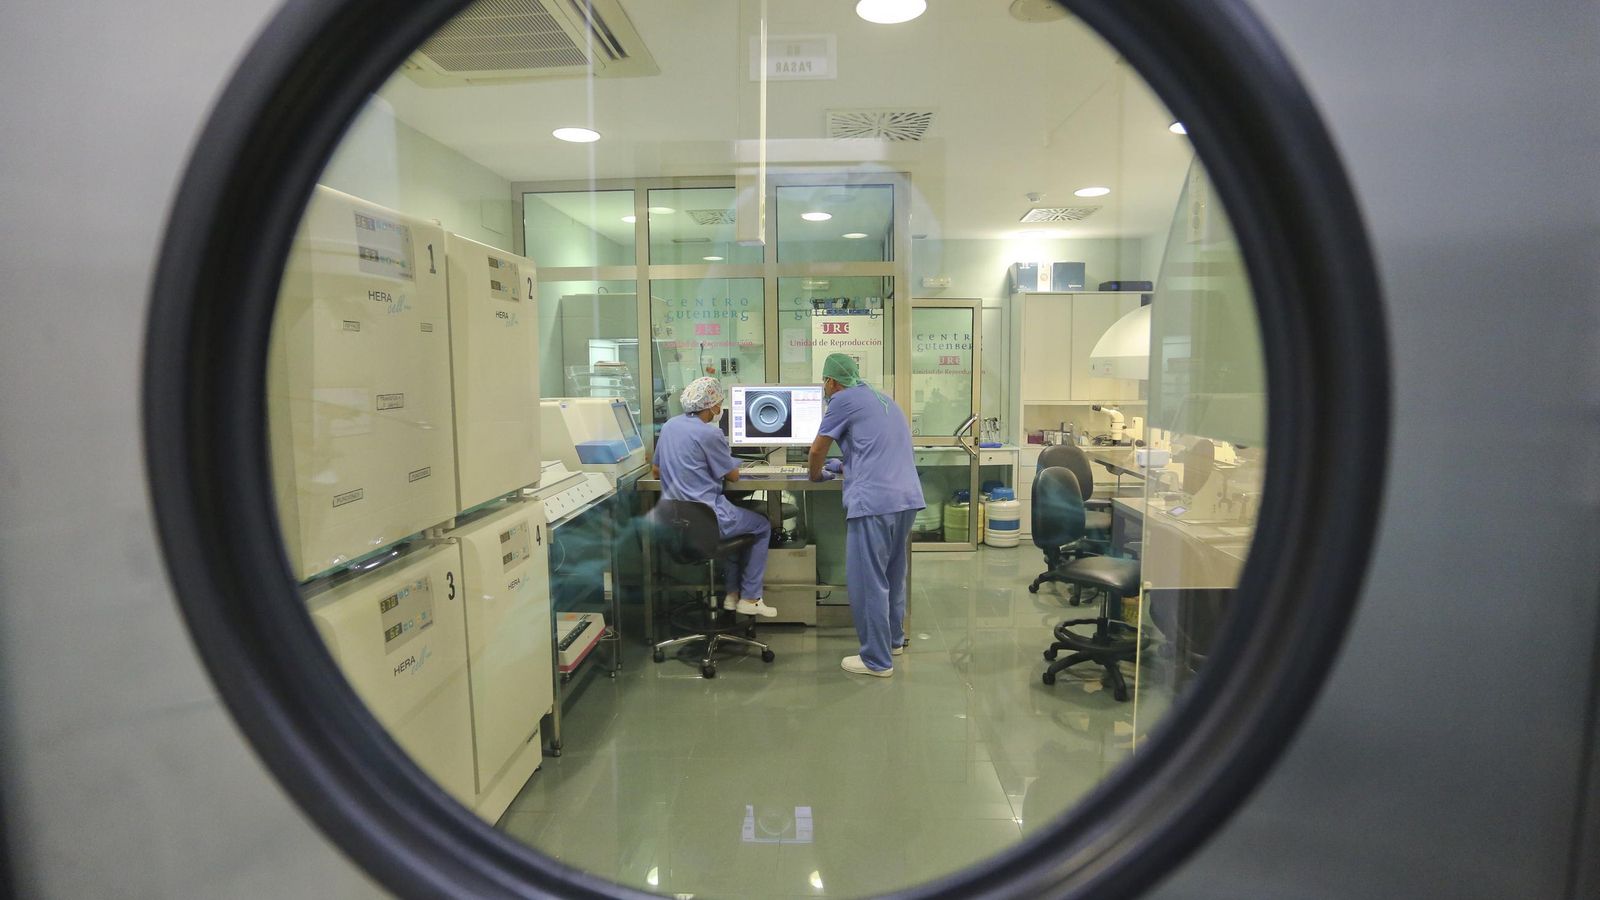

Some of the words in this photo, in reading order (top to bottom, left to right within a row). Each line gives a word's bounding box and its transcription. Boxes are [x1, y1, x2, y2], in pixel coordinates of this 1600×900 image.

[427, 243, 437, 274] 1
[368, 290, 393, 303] HERA
[527, 276, 534, 300] 2
[495, 310, 509, 319] HERA
[790, 338, 817, 347] Unidad
[818, 339, 829, 347] de
[830, 338, 882, 349] Reproducción
[917, 333, 972, 341] CENTR
[535, 525, 542, 546] 4
[446, 571, 455, 601] 3
[393, 655, 416, 677] HERA
